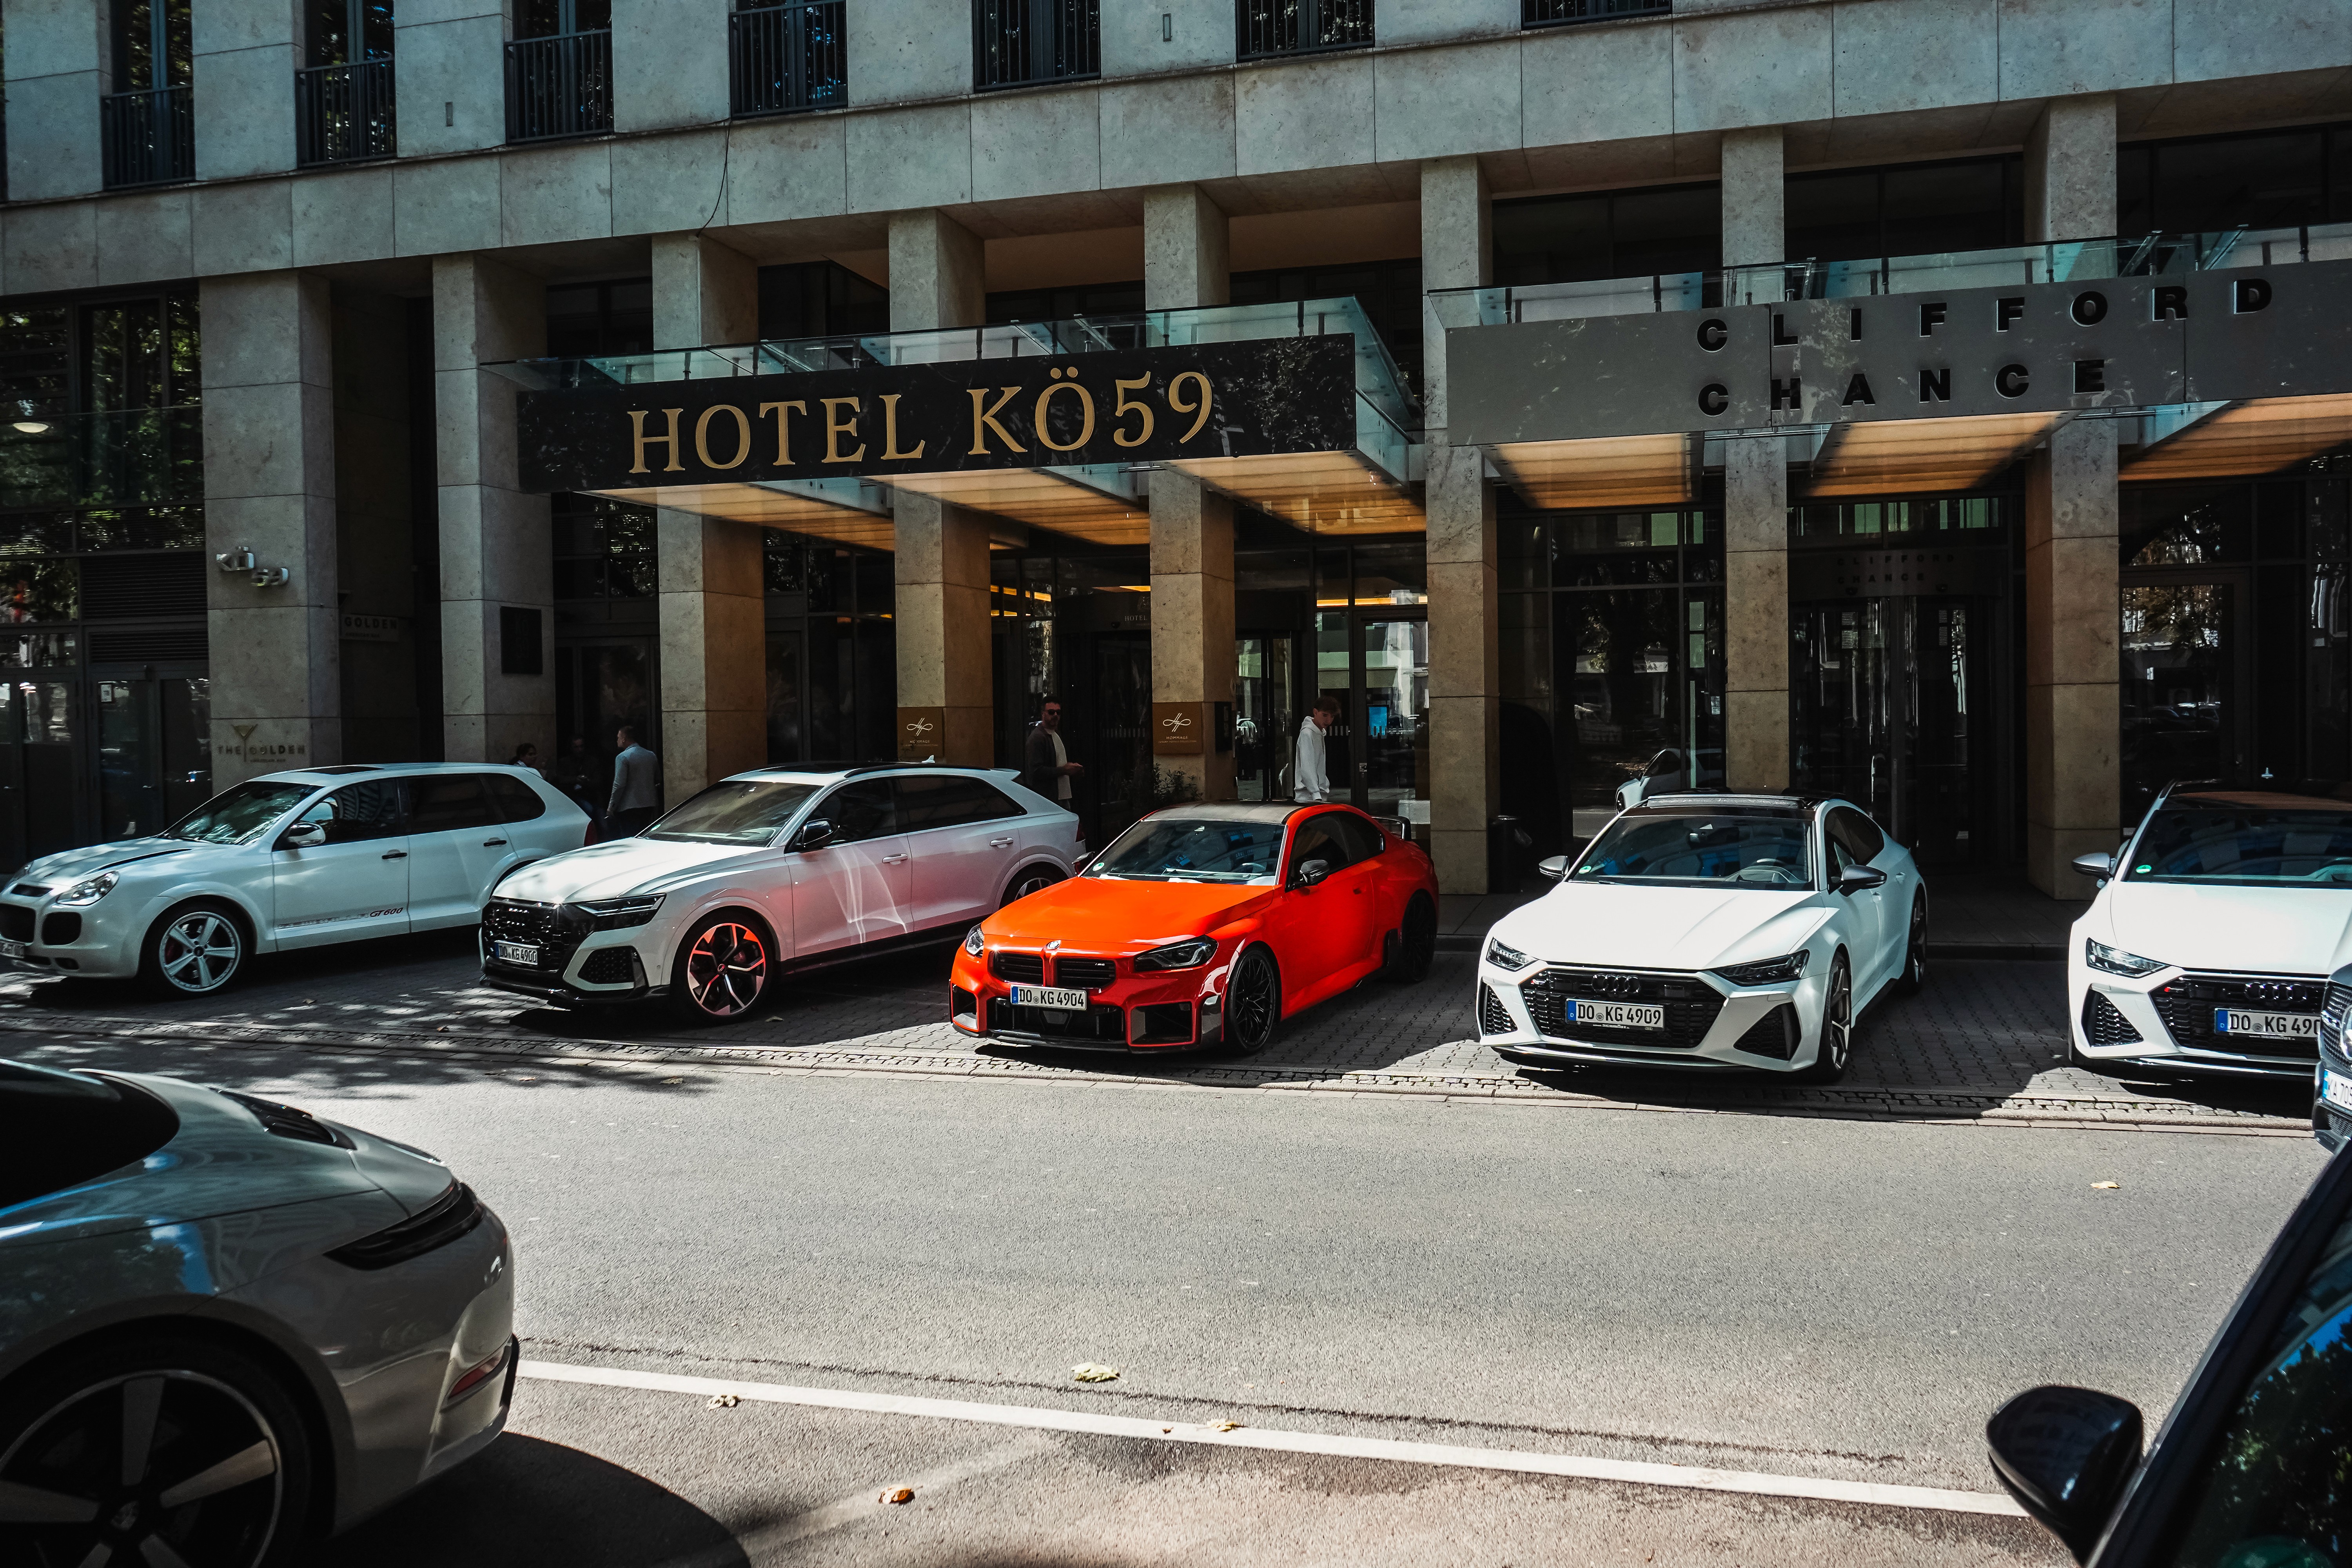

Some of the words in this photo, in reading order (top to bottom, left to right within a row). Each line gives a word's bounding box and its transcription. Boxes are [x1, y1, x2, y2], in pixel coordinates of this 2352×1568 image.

[1697, 278, 2272, 353] CLIFFORD
[1697, 359, 2105, 417] CHANCE
[628, 395, 925, 473] HOTEL
[967, 367, 1212, 455] KÖ59
[1837, 554, 1954, 566] CLIFFORD
[1837, 573, 1924, 584] CHANCE
[344, 617, 397, 629] GOLDEN
[218, 745, 241, 754] THE
[249, 745, 305, 755] GOLDEN
[1019, 989, 1033, 1003] DO
[1040, 990, 1054, 1005] KG
[1057, 992, 1084, 1007] 4904
[1577, 1004, 1595, 1020] DO
[1605, 1006, 1623, 1022] KG
[1626, 1007, 1661, 1025] 4909
[2230, 1013, 2251, 1031] DO
[2265, 1016, 2287, 1033] KG
